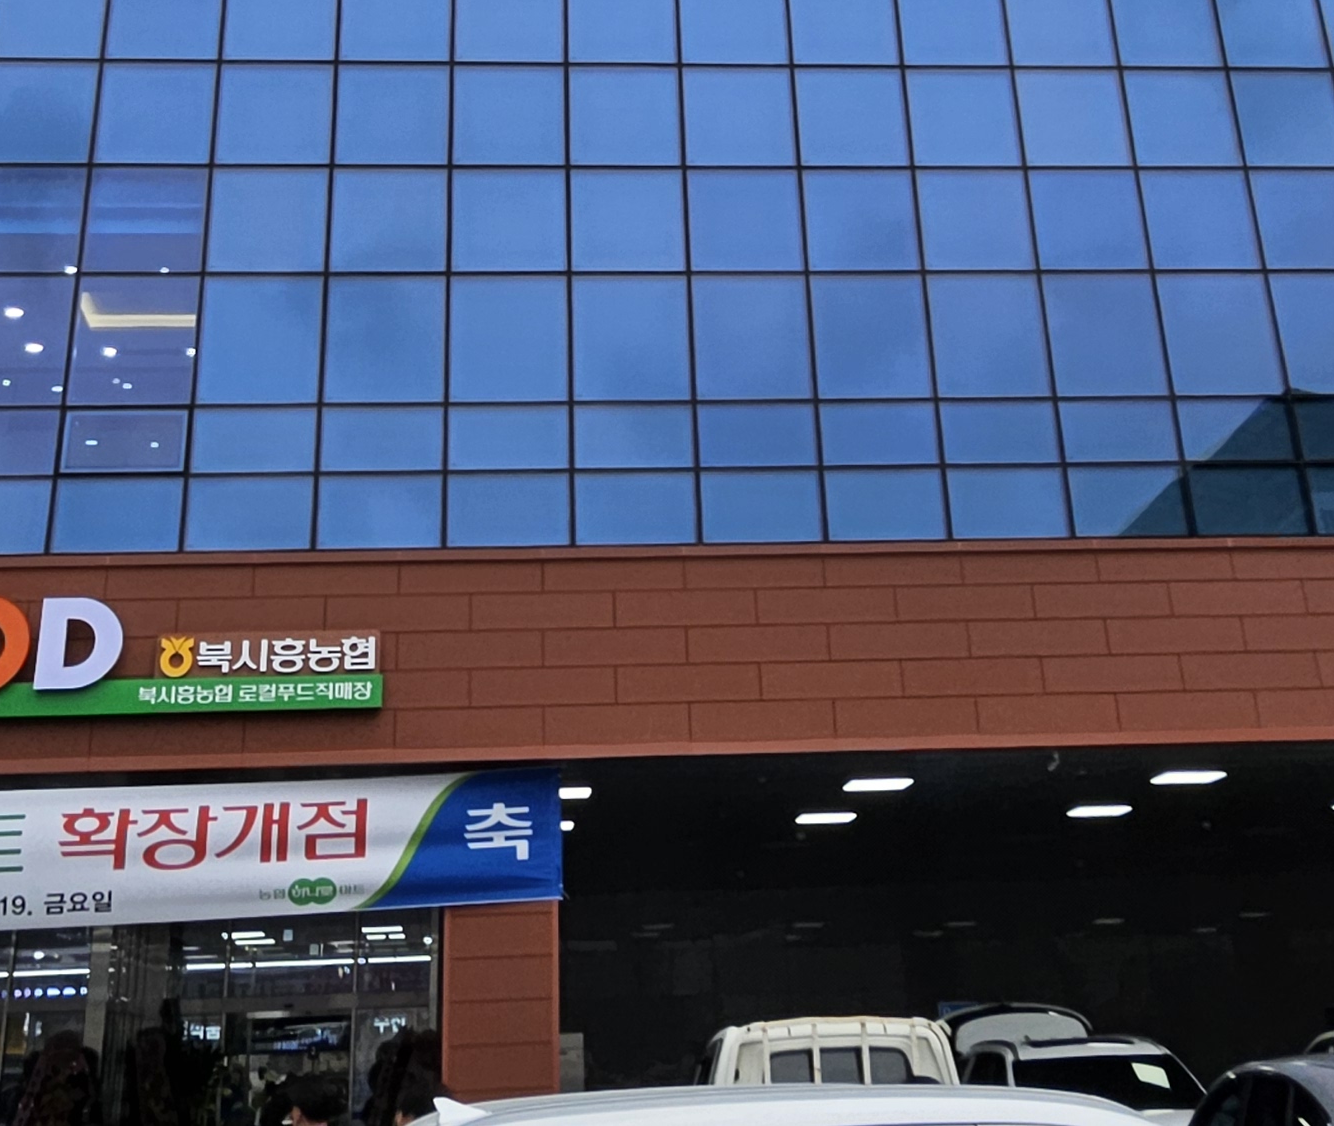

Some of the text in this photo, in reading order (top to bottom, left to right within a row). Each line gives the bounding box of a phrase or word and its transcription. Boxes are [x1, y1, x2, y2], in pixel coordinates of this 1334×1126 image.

[197, 636, 376, 674] 북시흥농협
[139, 681, 373, 704] 북시흥농협 로컬푸드직매장
[58, 798, 369, 871] 확장개점
[463, 802, 534, 861] 축
[43, 890, 113, 915] 금요일
